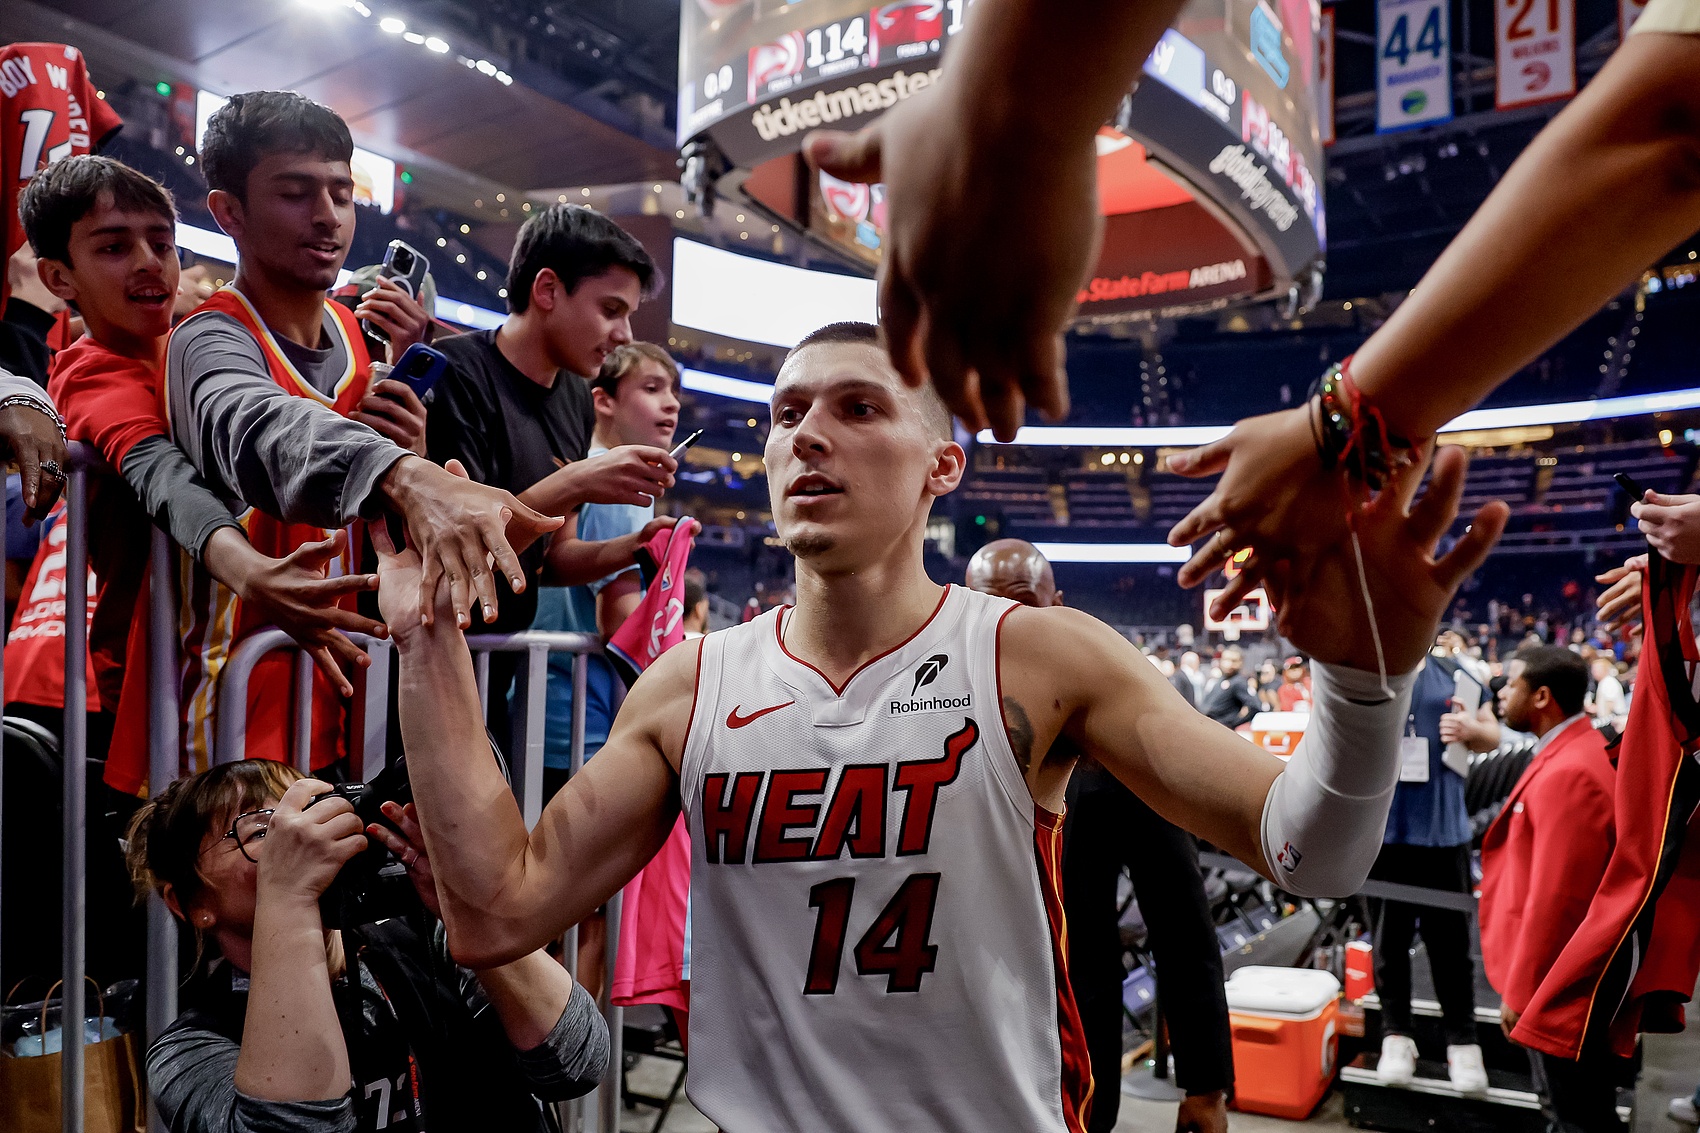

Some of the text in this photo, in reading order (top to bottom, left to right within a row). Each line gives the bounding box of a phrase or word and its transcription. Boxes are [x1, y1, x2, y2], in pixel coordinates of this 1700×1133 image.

[806, 17, 868, 68] 114
[1383, 6, 1442, 66] 44
[1506, 0, 1560, 42] 21
[752, 68, 943, 141] ticketmaster
[20, 109, 72, 180] 1
[890, 694, 971, 715] Robinhood
[702, 717, 979, 865] HEAT
[803, 872, 941, 995] 14
